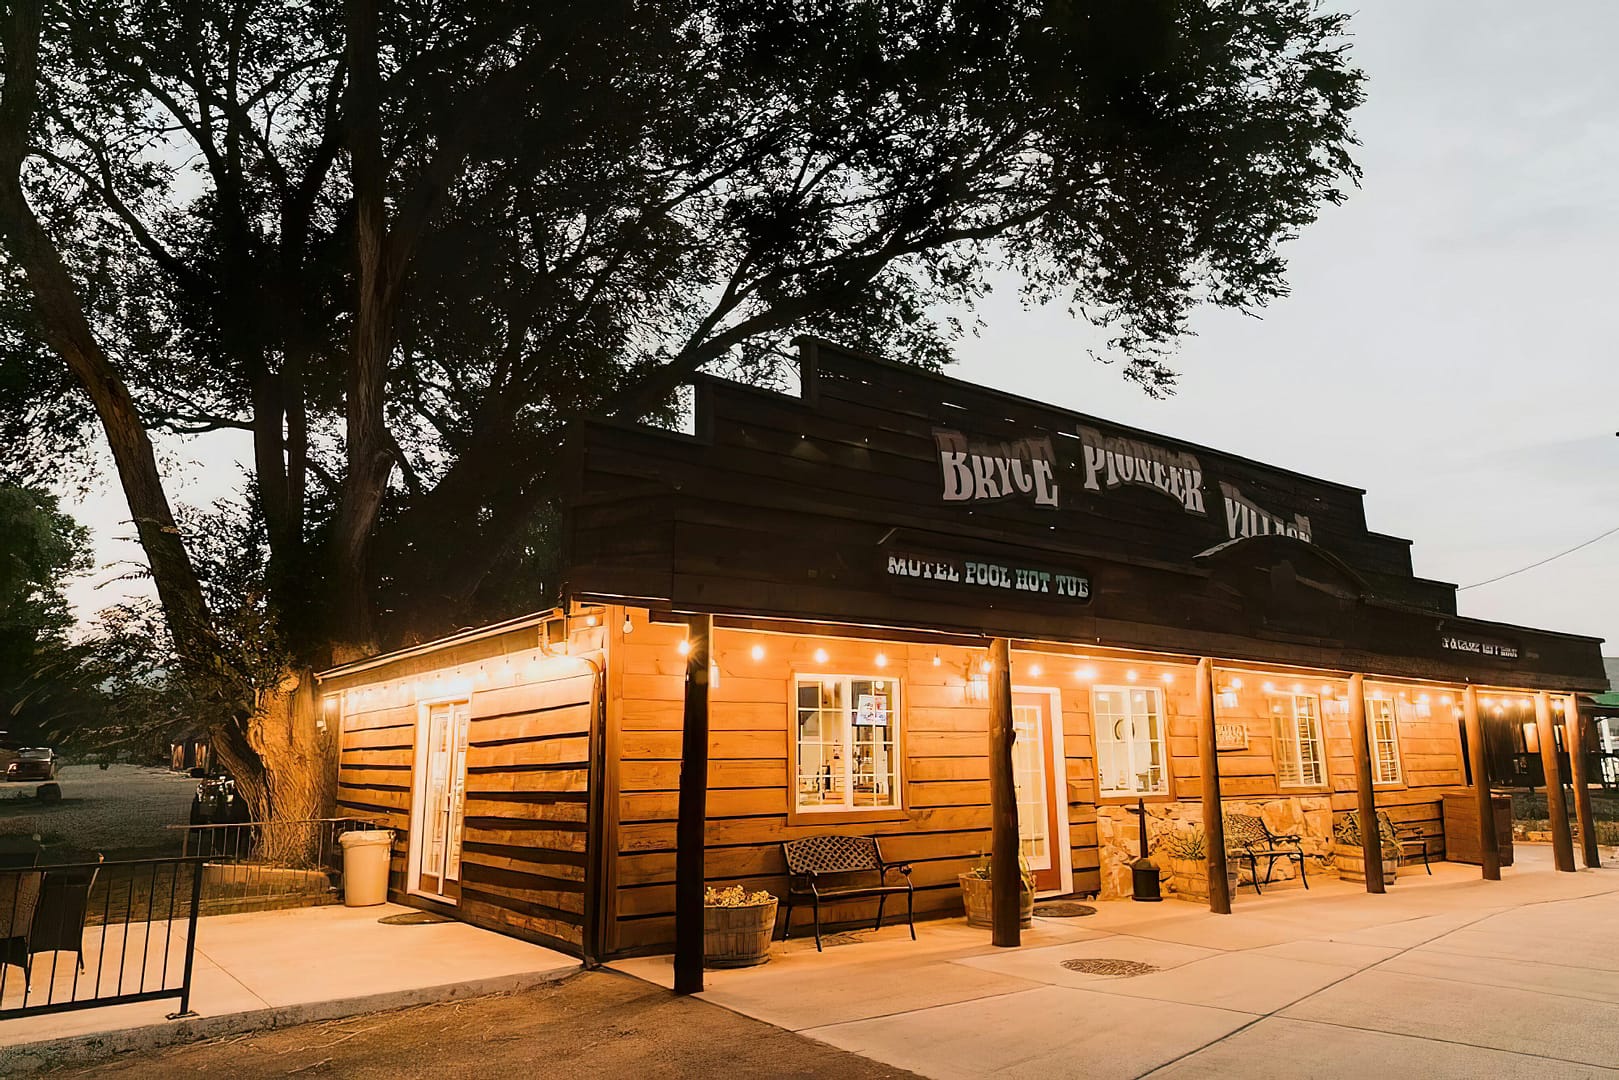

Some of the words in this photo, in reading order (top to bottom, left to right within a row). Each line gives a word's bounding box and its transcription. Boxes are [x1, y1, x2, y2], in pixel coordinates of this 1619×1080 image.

[932, 428, 1059, 507] BRYCE
[1077, 425, 1206, 514] PIONEER
[887, 555, 960, 583] MOTEL
[964, 561, 1012, 590] POOL
[1015, 568, 1050, 593] HOT
[1055, 574, 1090, 599] TUB
